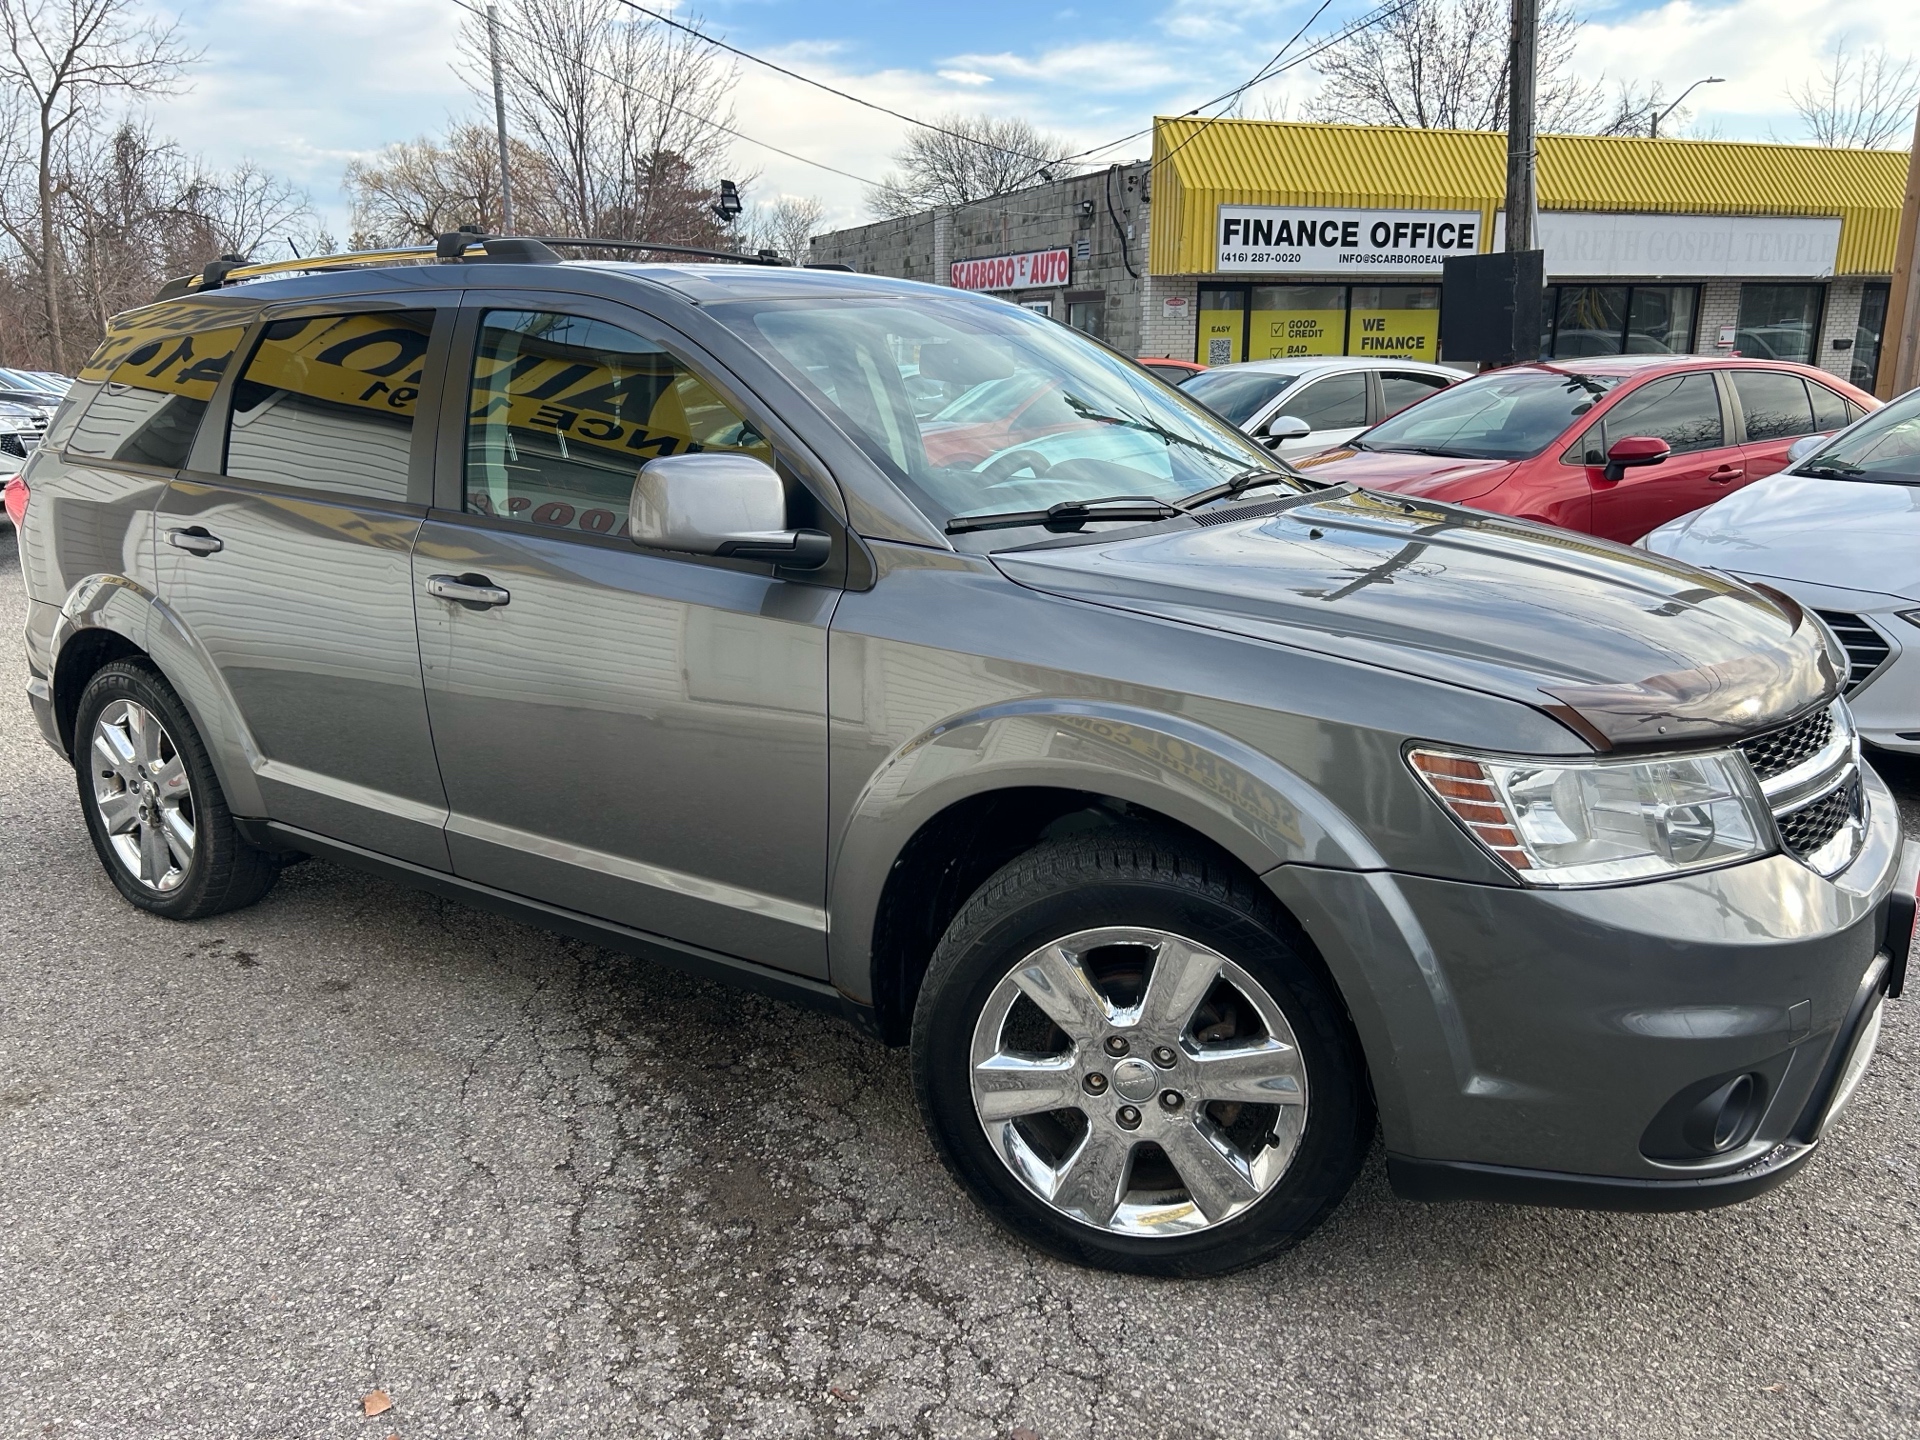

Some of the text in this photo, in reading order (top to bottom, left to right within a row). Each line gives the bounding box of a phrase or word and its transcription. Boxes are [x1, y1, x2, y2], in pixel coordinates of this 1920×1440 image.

[1223, 218, 1476, 250] FINANCE OFFICE
[1540, 229, 1836, 263] ZARETH GOSPEL TEMPLE
[1221, 252, 1457, 265] (416) 287-0020 INFO@SCARBOROEAU
[951, 257, 1015, 290] SCARBORO
[1029, 250, 1068, 285] AUTO
[1211, 325, 1231, 333] EASY
[1288, 319, 1317, 329] GOOD
[1362, 318, 1386, 332] WE
[1287, 329, 1324, 339] CREDIT
[1287, 345, 1308, 354] BAD
[1361, 336, 1425, 350] FINANCE
